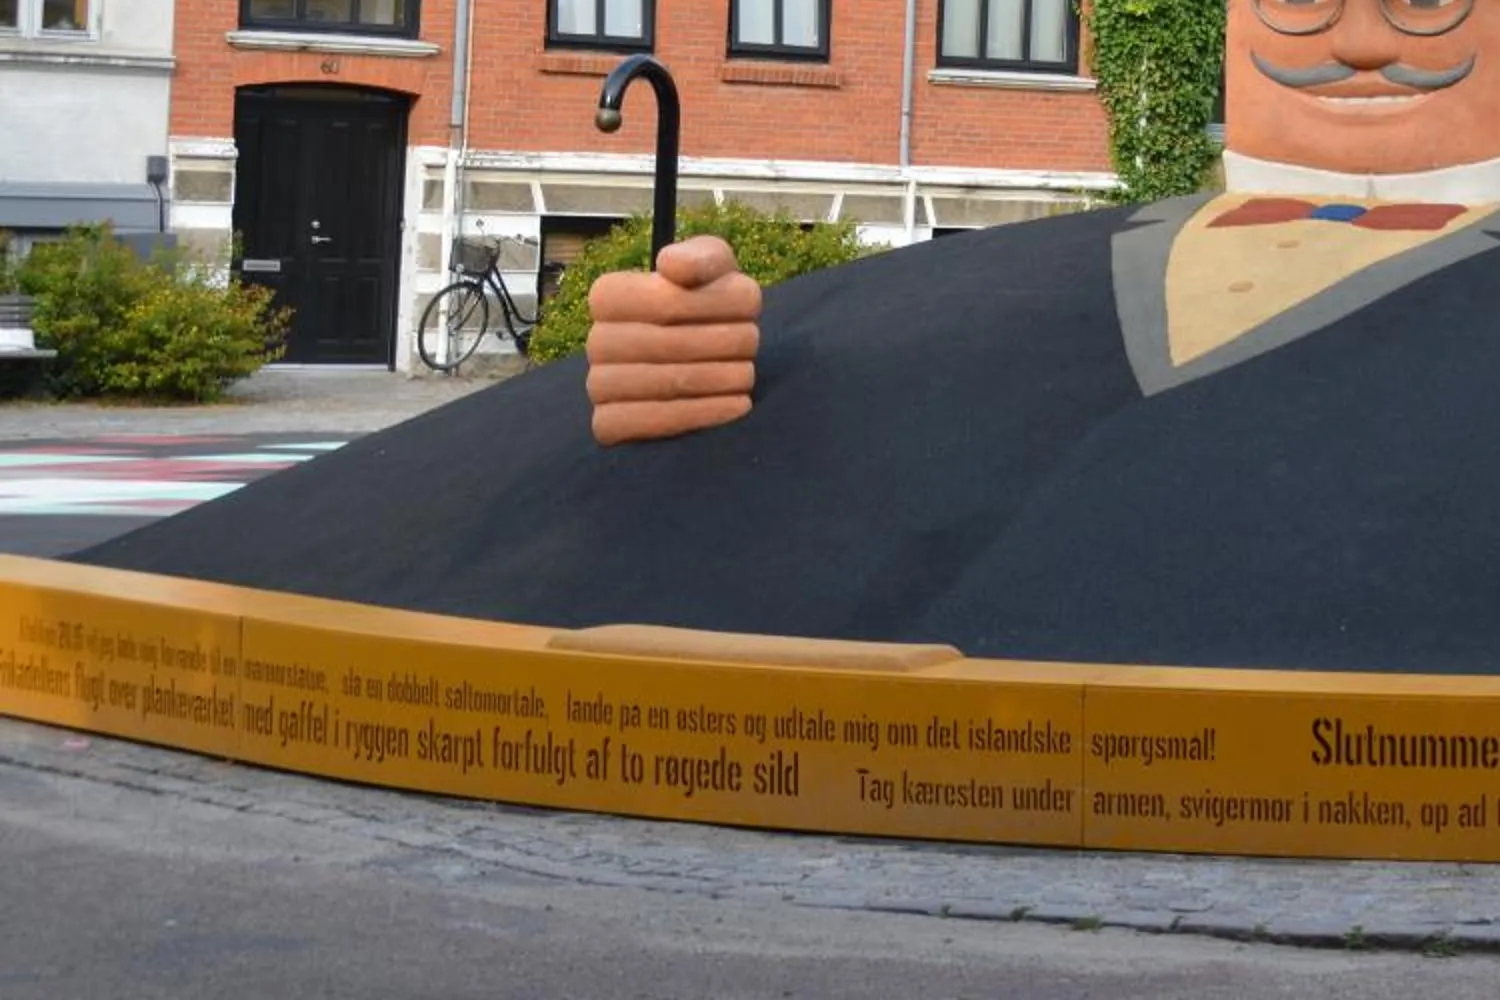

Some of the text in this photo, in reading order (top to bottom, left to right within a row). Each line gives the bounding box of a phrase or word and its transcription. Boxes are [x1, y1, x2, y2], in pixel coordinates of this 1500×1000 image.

[278, 700, 329, 747] gaffel
[333, 708, 340, 748] i
[345, 719, 409, 764] ryggen
[417, 715, 484, 776] skarpt
[493, 725, 576, 786] forfulgt
[586, 736, 611, 781] af
[621, 743, 644, 783] to
[655, 745, 742, 798] røgede
[753, 750, 799, 797] sild
[366, 677, 383, 702] en
[387, 672, 439, 707] dobbelt
[567, 687, 613, 726] lande
[648, 705, 669, 730] en
[676, 704, 736, 735] østers
[744, 712, 767, 744] og
[774, 704, 836, 742] udtale
[843, 713, 879, 751] mig
[887, 722, 918, 747] om
[926, 715, 960, 751] det
[968, 717, 1071, 754] islandske
[856, 767, 895, 810] Tag
[902, 769, 1003, 809] kæresten
[1012, 777, 1074, 812] under
[1092, 790, 1171, 821] armen,
[1179, 788, 1294, 827] svigermor
[1303, 791, 1310, 824] i
[1318, 790, 1412, 830] nakken,
[1420, 802, 1448, 834] op
[1457, 793, 1486, 828] ad
